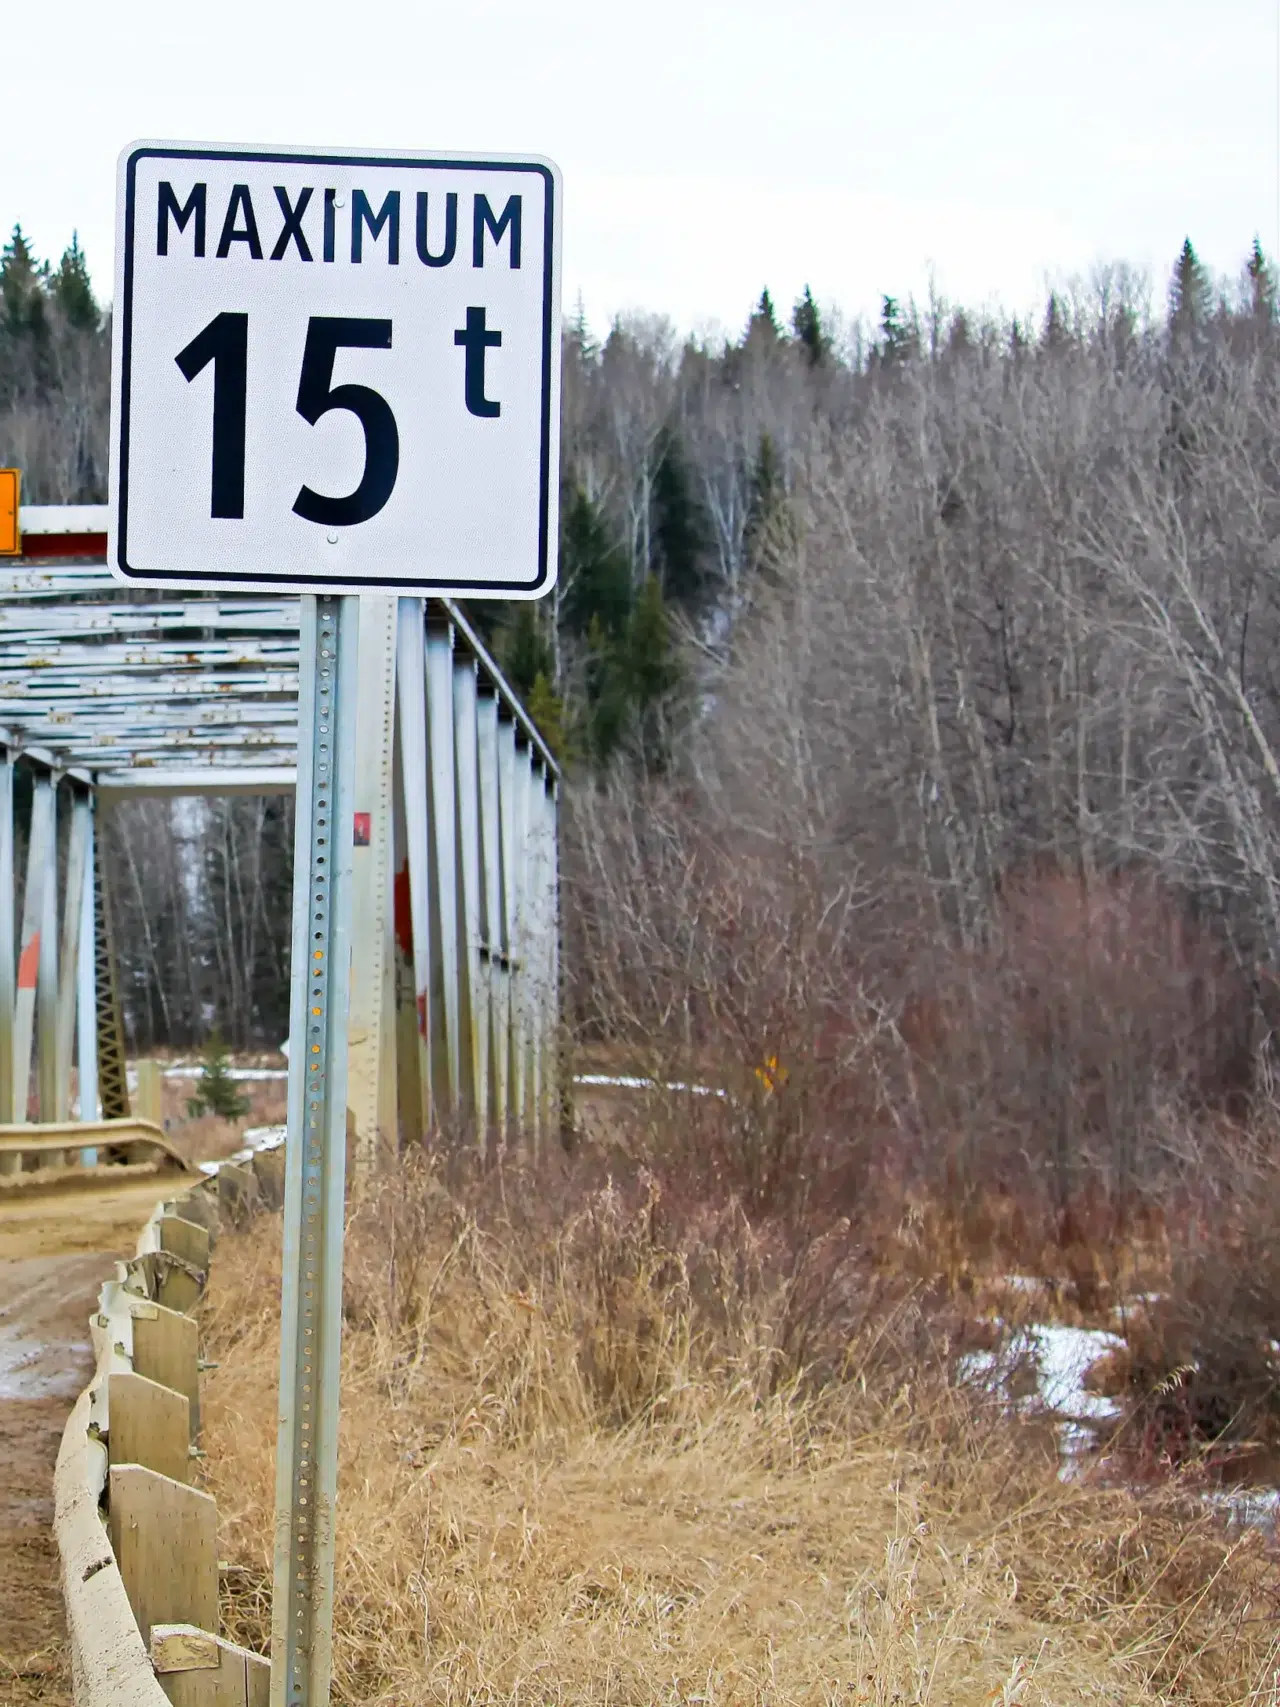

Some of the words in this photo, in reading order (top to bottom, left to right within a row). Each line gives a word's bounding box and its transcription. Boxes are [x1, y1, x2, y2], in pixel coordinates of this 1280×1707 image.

[156, 181, 523, 270] MAXIMUM
[173, 311, 400, 527] 15
[453, 306, 502, 418] t
